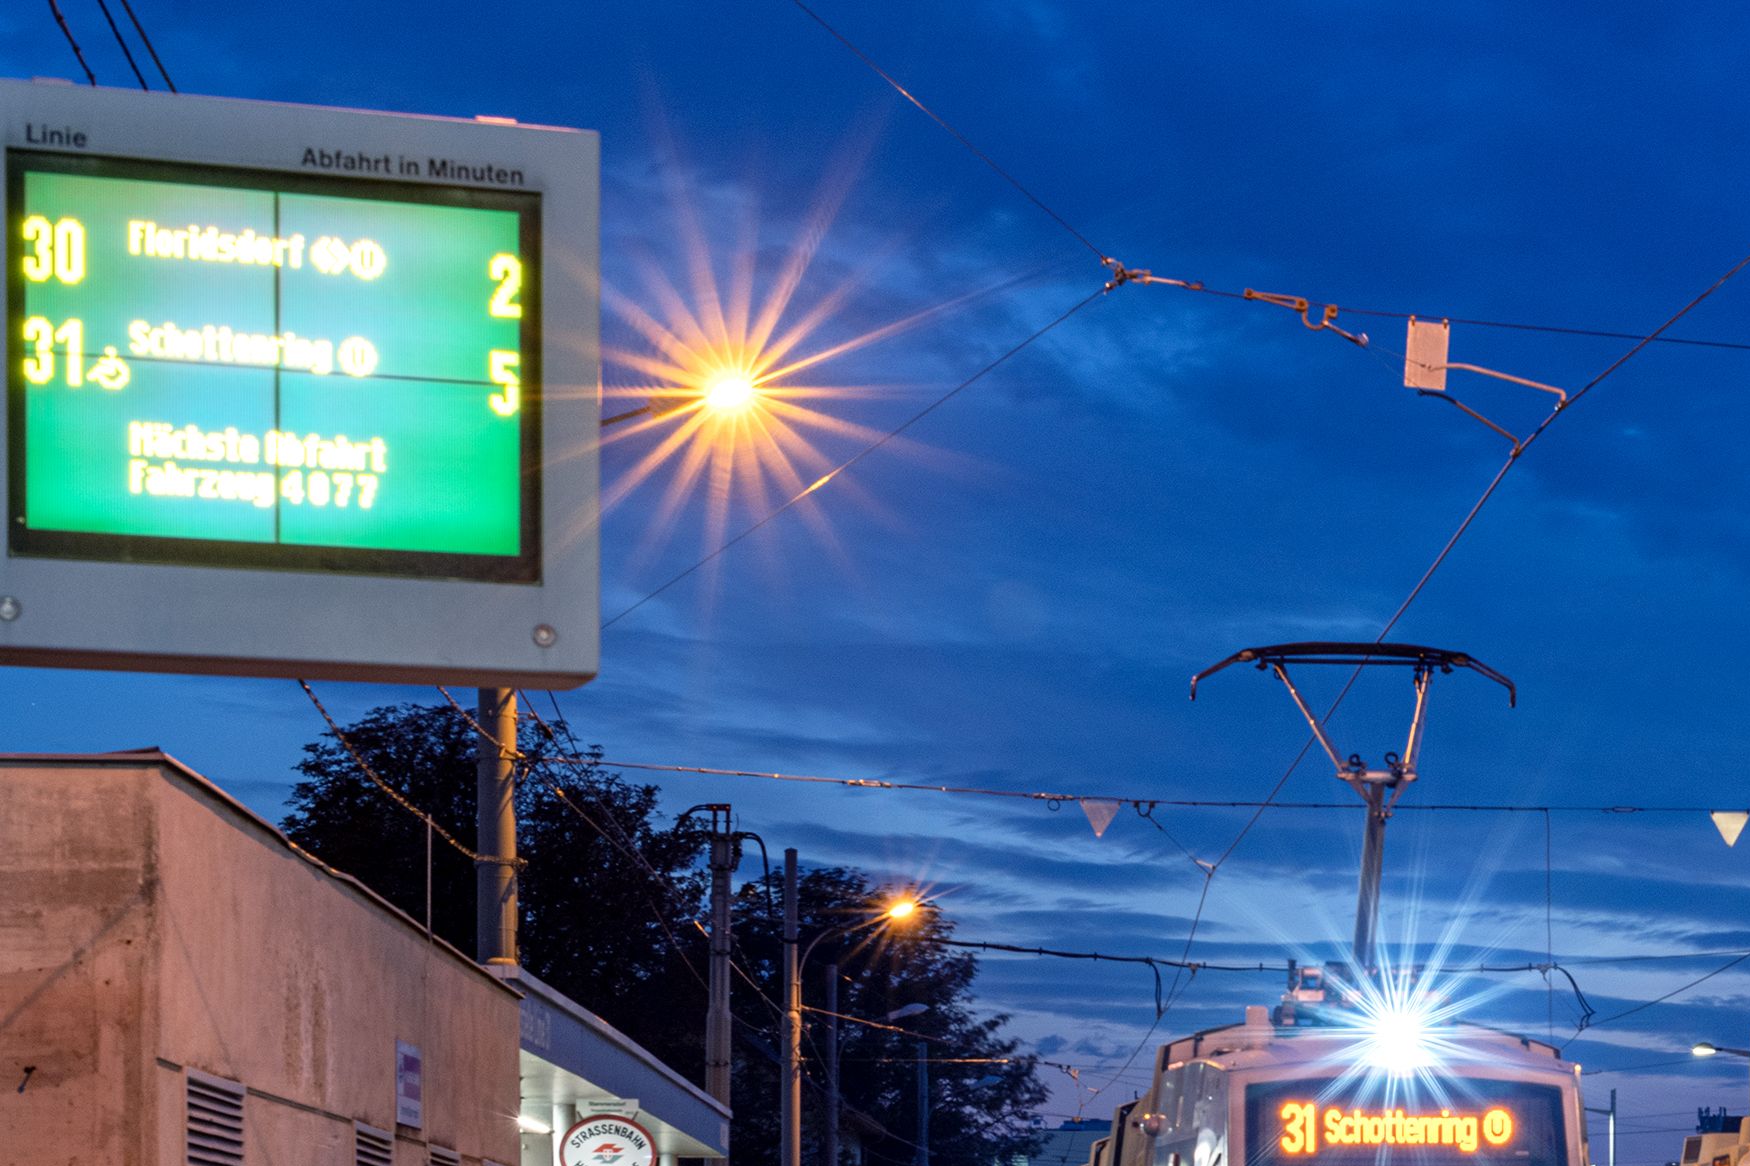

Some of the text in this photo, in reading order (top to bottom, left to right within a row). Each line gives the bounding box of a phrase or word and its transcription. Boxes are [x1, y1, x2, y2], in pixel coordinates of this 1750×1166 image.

[24, 123, 88, 149] Linie
[301, 147, 525, 186] Abfahrt in Minuten
[22, 215, 87, 285] 30
[128, 220, 305, 269] Floridsdorf
[488, 252, 523, 319] 2
[22, 315, 84, 388] 31
[128, 319, 333, 375] Schottenring
[488, 349, 521, 417] 5
[128, 420, 388, 473] Nächste Abfahrt
[128, 457, 379, 510] Fahrzeug 4077
[571, 1124, 646, 1150] STRASSENBAHN
[1280, 1102, 1316, 1153] 31
[1323, 1108, 1478, 1152] Schottenring
